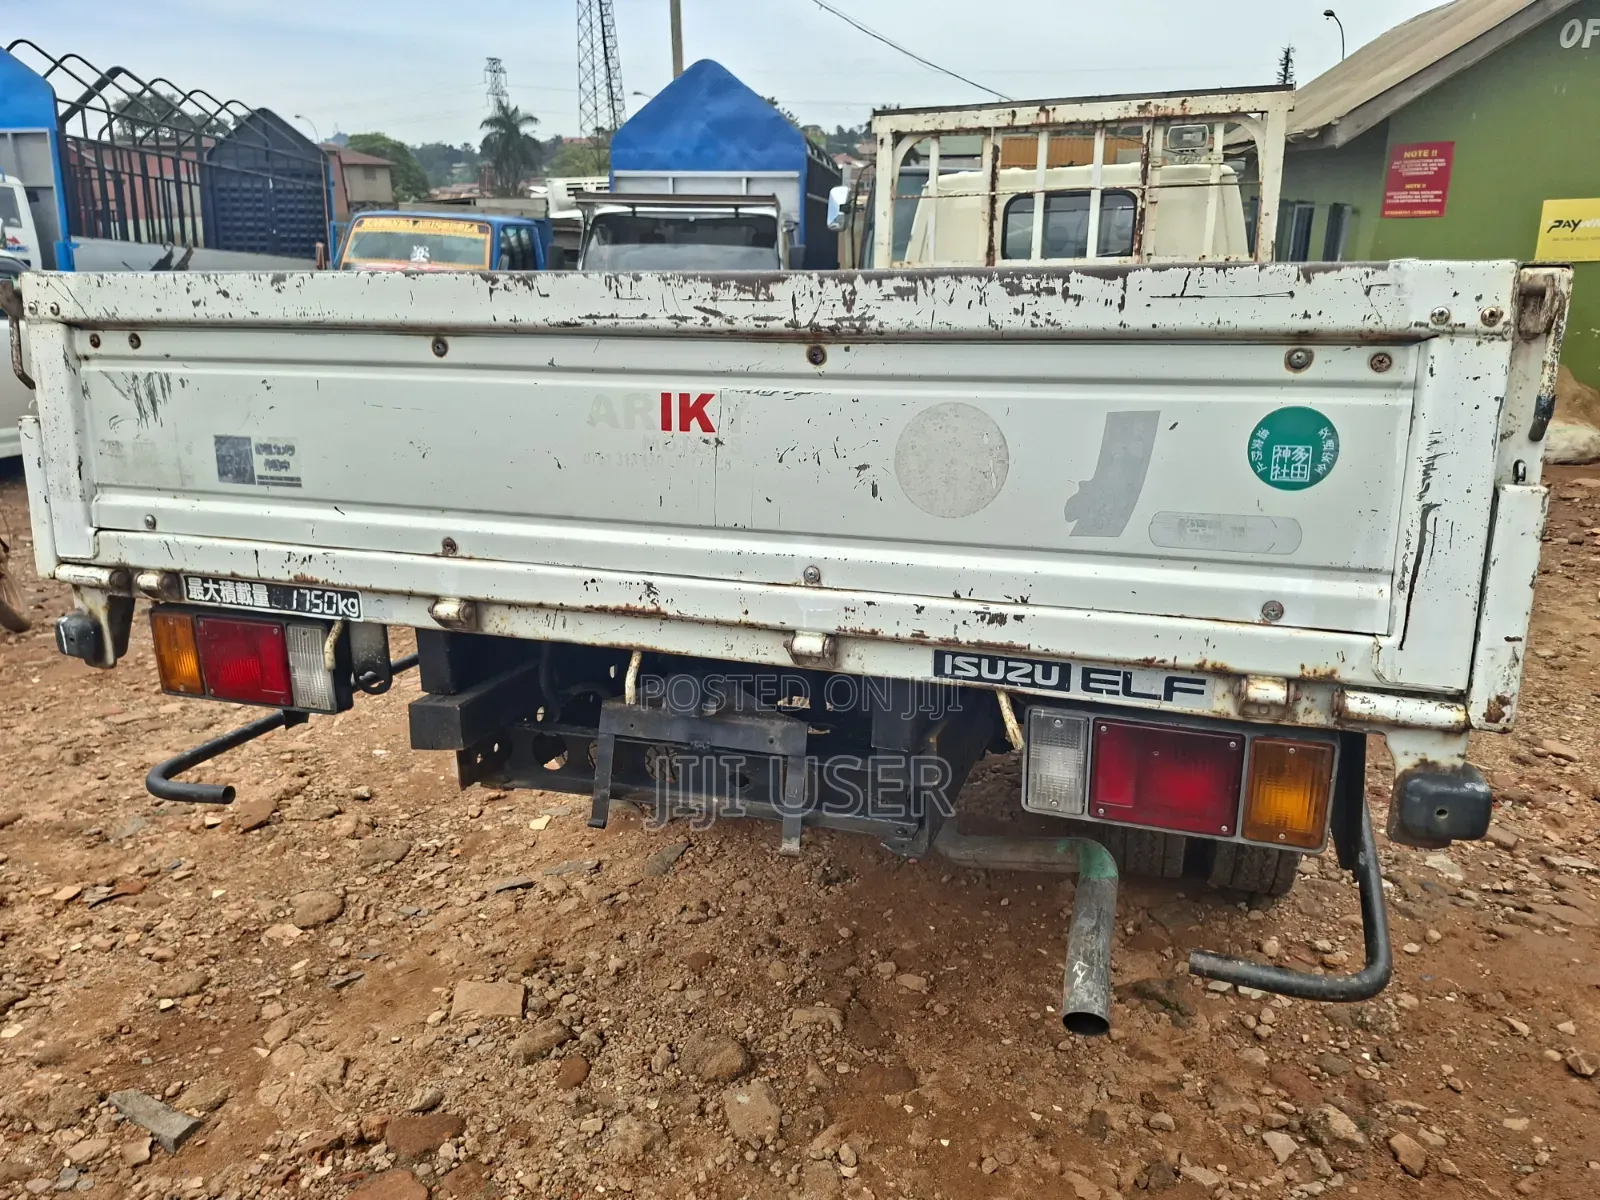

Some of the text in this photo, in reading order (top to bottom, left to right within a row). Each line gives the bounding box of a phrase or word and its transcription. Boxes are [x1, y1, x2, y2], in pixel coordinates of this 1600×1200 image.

[1560, 18, 1600, 49] OF
[1404, 149, 1429, 158] NOTE
[188, 577, 359, 618] 最大積載量 1750kg
[944, 654, 1208, 703] ISUZU ELF
